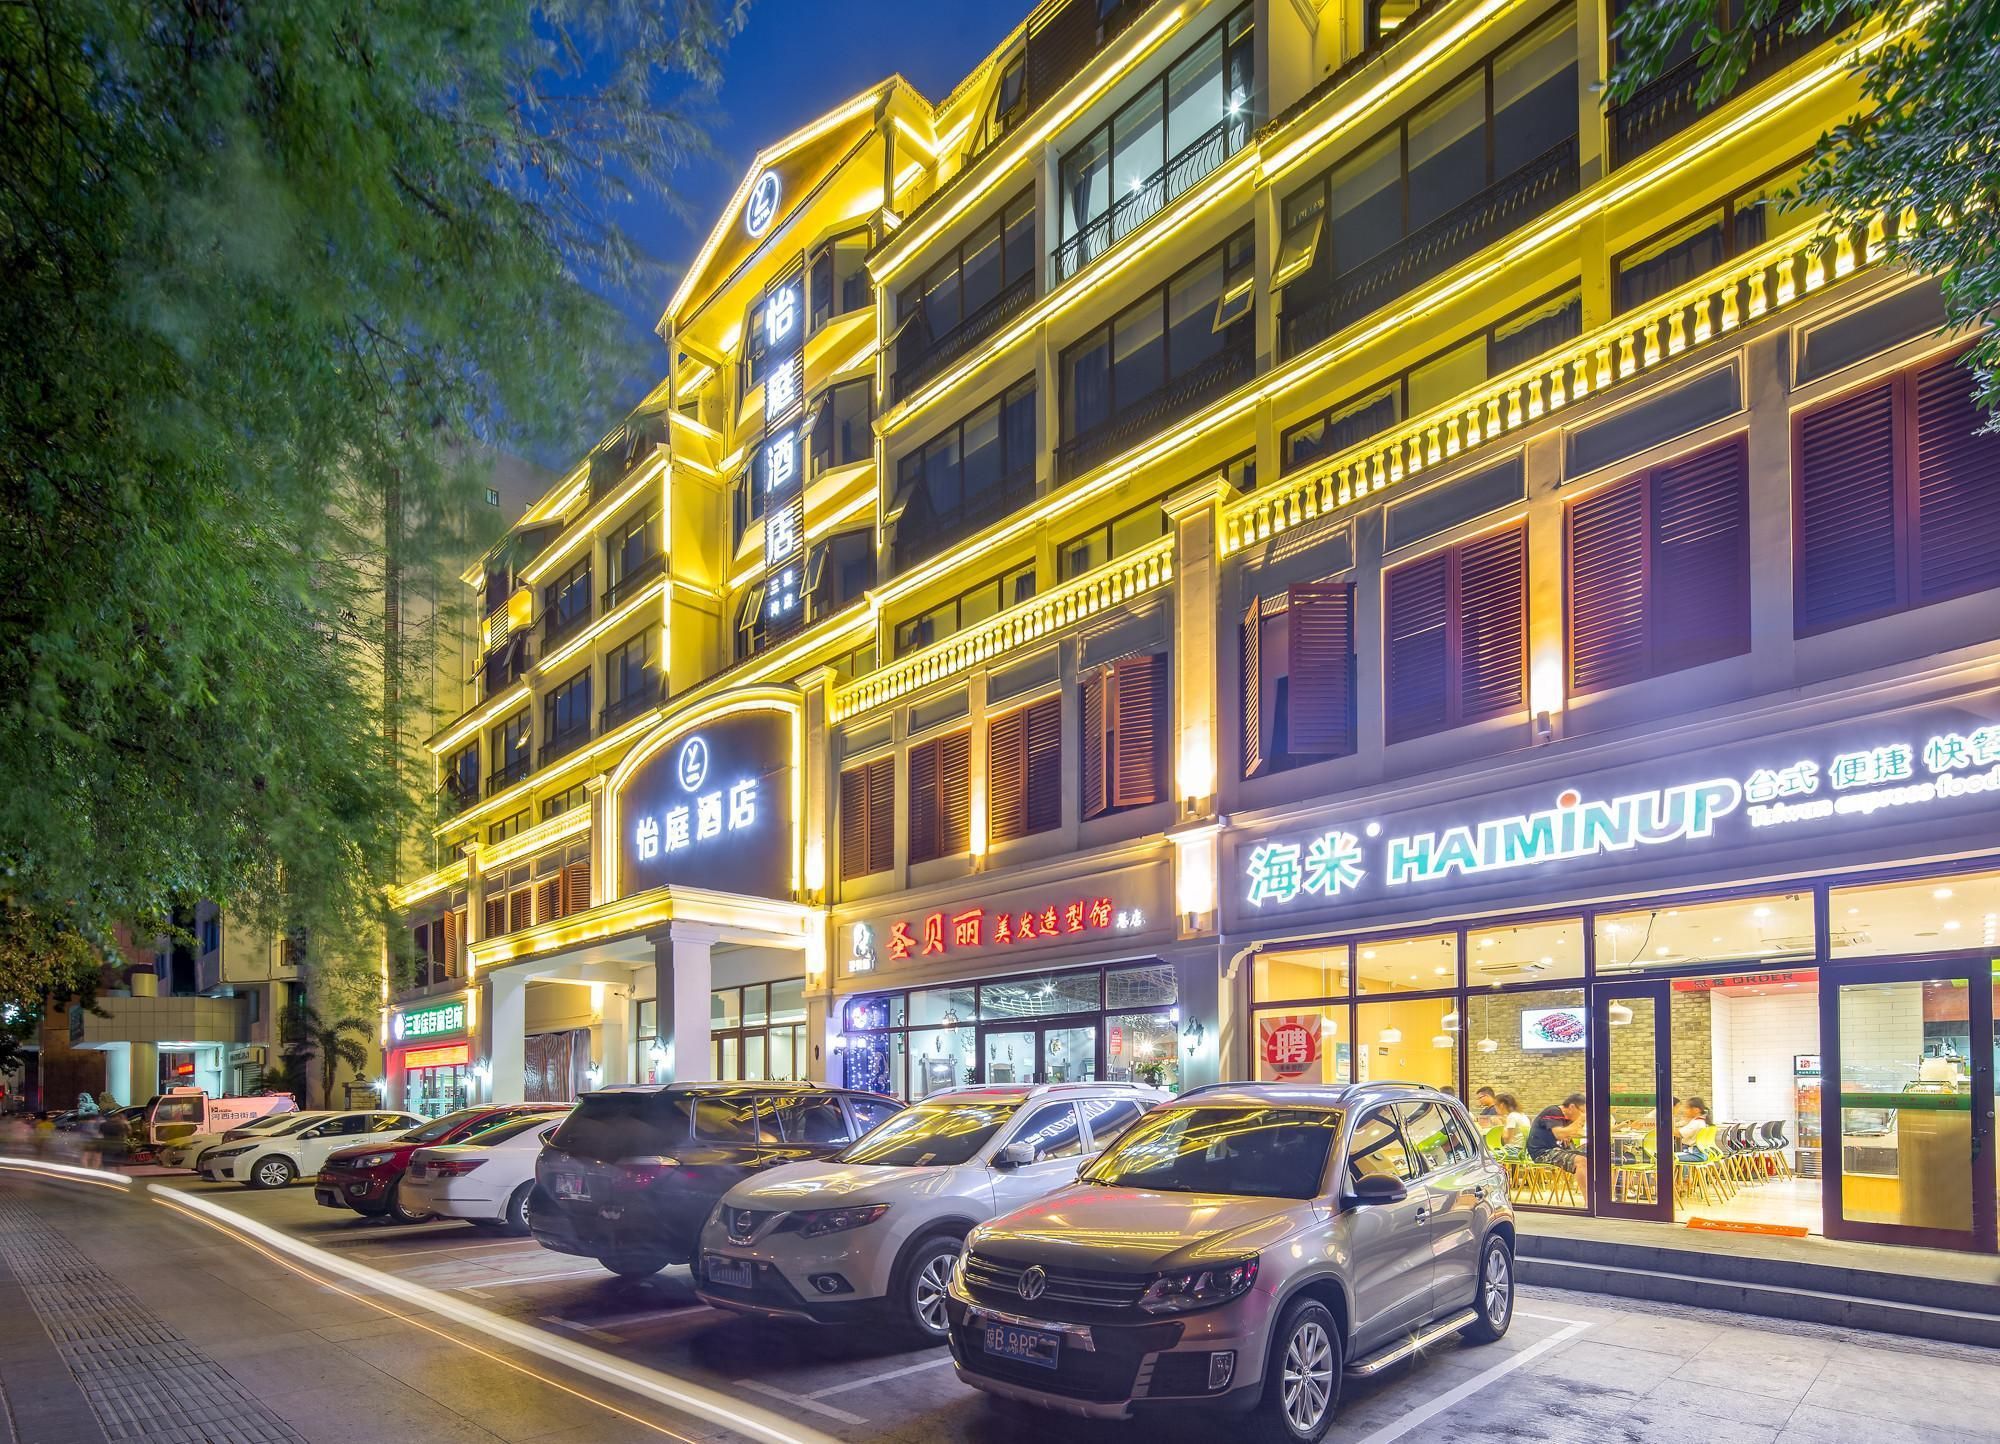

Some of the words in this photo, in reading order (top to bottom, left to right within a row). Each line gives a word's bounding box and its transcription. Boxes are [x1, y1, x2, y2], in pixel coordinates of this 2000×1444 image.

[766, 286, 796, 568] 怡庭酒店
[1744, 760, 1818, 802] 台式
[1829, 744, 1912, 789] 便捷
[1924, 724, 2000, 772] 快餐
[636, 778, 758, 861] 怡庭酒店
[1246, 831, 1366, 906] 海米
[886, 908, 984, 960] 圣贝丽
[992, 898, 1112, 944] 美发造型馆
[1733, 973, 1793, 985] ORDER
[1275, 1028, 1307, 1063] 聘
